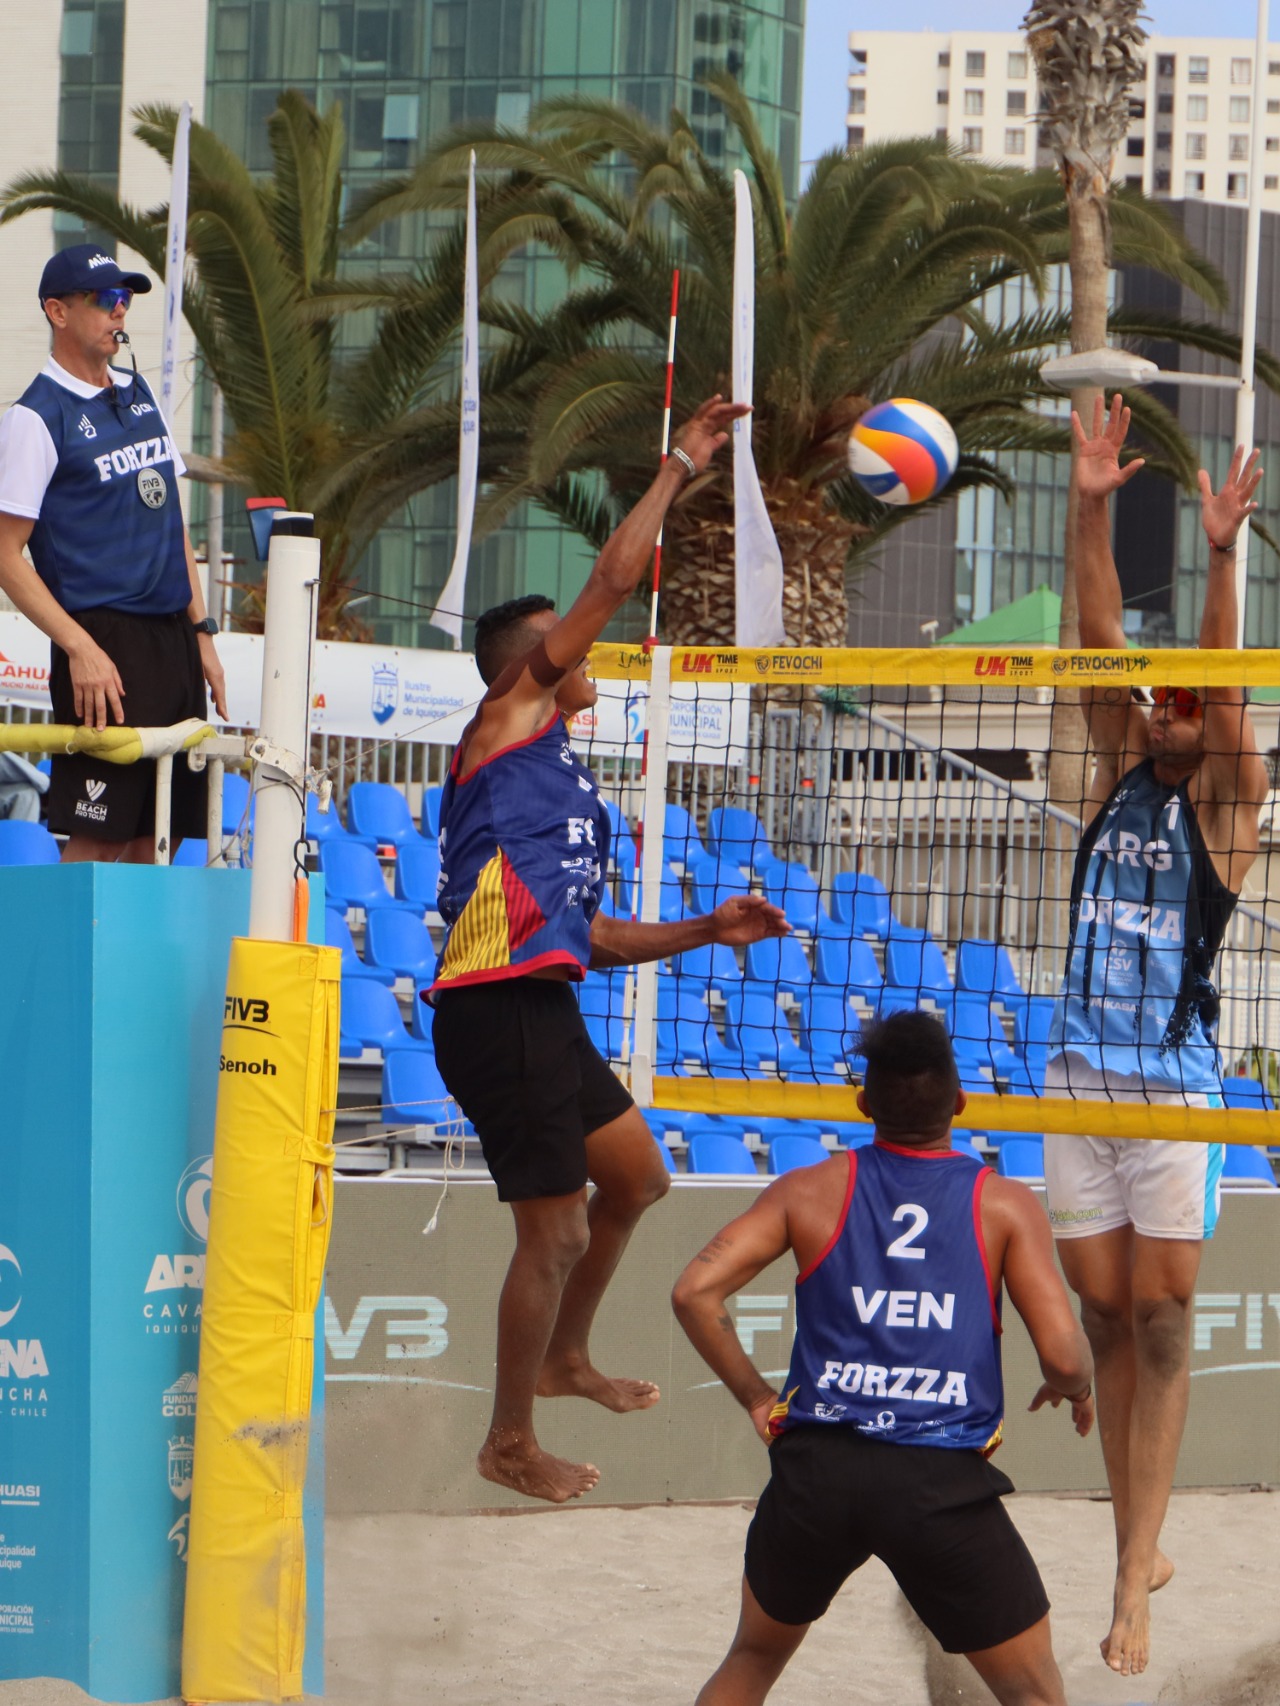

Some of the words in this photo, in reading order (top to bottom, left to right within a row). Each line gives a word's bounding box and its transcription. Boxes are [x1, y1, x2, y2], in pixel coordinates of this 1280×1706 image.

[94, 436, 173, 482] FORZZA
[682, 653, 715, 673] UK
[716, 654, 739, 664] TIME
[772, 655, 823, 669] FEVOCHI
[974, 656, 1010, 676] UK
[1010, 656, 1033, 666] TIME
[1071, 656, 1123, 671] FEVOCHI
[404, 680, 431, 692] Ilustre
[404, 692, 464, 707] Municipalidad
[403, 707, 413, 716] de
[415, 708, 447, 720] Iquique
[76, 801, 107, 816] BEACH
[88, 812, 106, 821] TOUR
[1164, 794, 1180, 830] 1
[1091, 829, 1173, 871] ARG
[1103, 957, 1132, 971] CSV
[224, 996, 270, 1023] FIVB
[219, 1055, 277, 1076] Senoh
[887, 1204, 929, 1259] 2
[852, 1286, 955, 1329] VEN
[817, 1360, 968, 1406] FORZZA
[11, 1408, 47, 1417] CHILE
